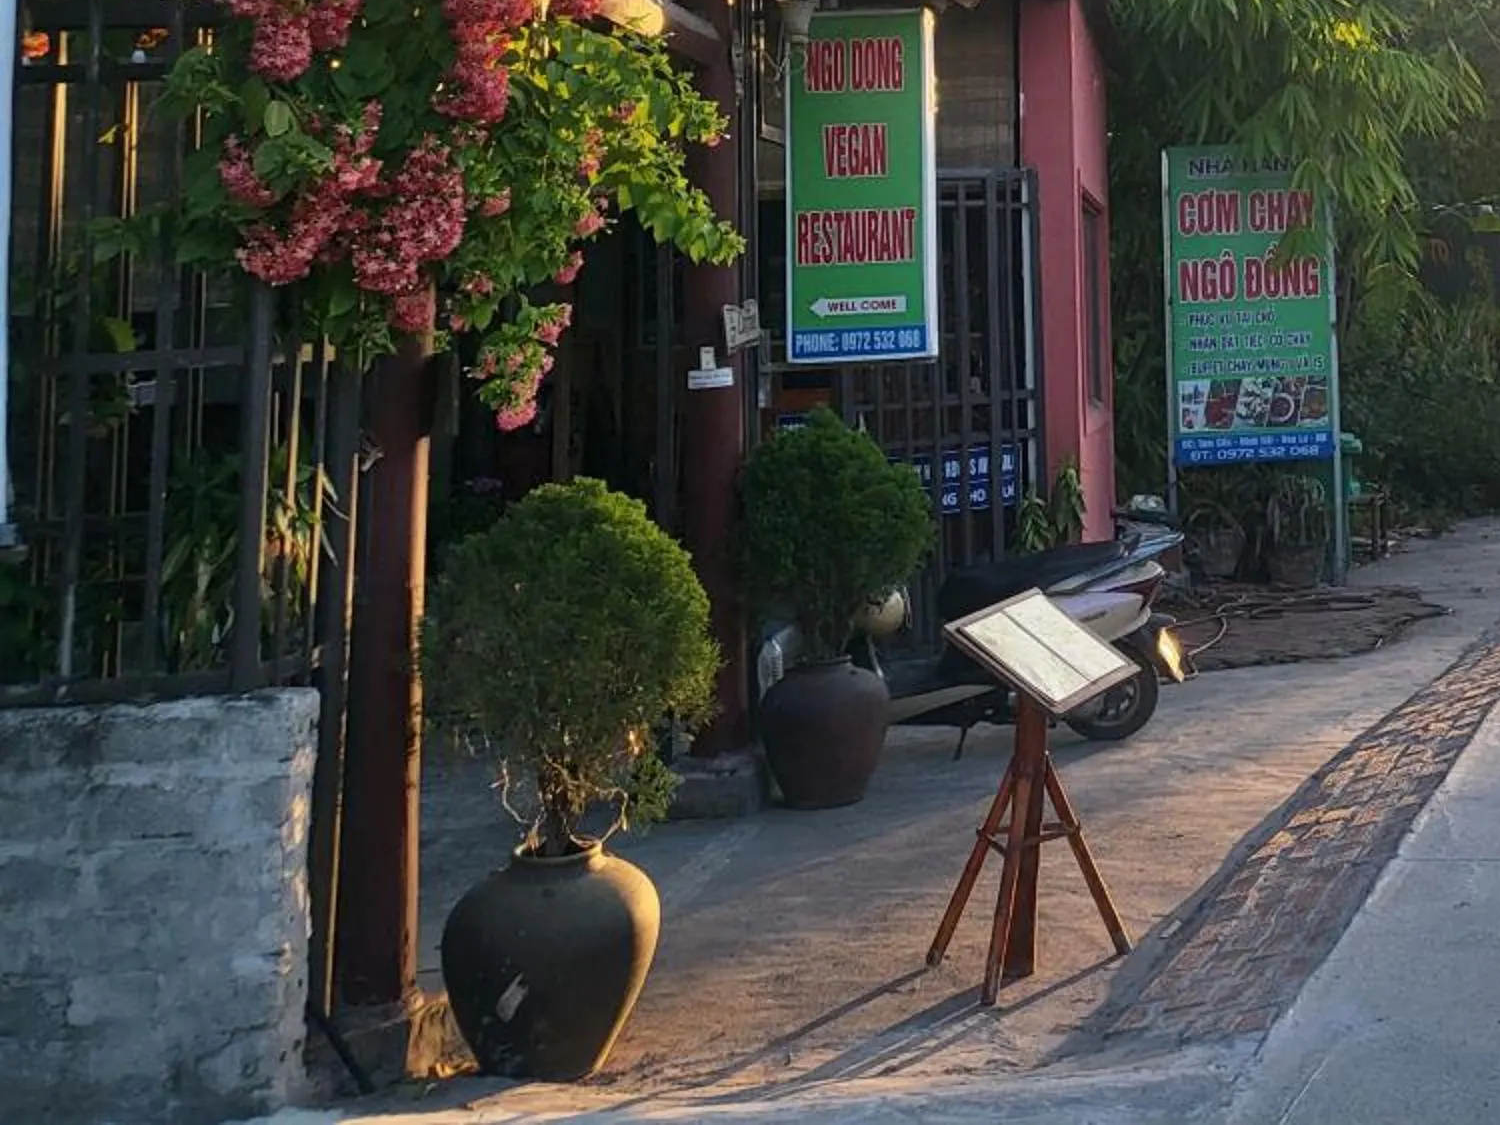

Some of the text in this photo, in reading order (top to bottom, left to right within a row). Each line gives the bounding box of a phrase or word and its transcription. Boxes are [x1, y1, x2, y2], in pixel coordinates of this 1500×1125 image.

[806, 36, 904, 92] NGO DONG
[823, 124, 888, 178] VEGAN
[796, 208, 916, 266] RESTAURANT
[1179, 189, 1241, 236] CƠM
[1179, 249, 1237, 303] NGÔ
[827, 299, 897, 312] WELL COME
[795, 332, 839, 353] PHONE:
[841, 331, 871, 351] 0972
[873, 330, 896, 350] 532
[1217, 447, 1255, 460] 0972
[1257, 445, 1286, 458] 532
[1289, 444, 1319, 456] 068
